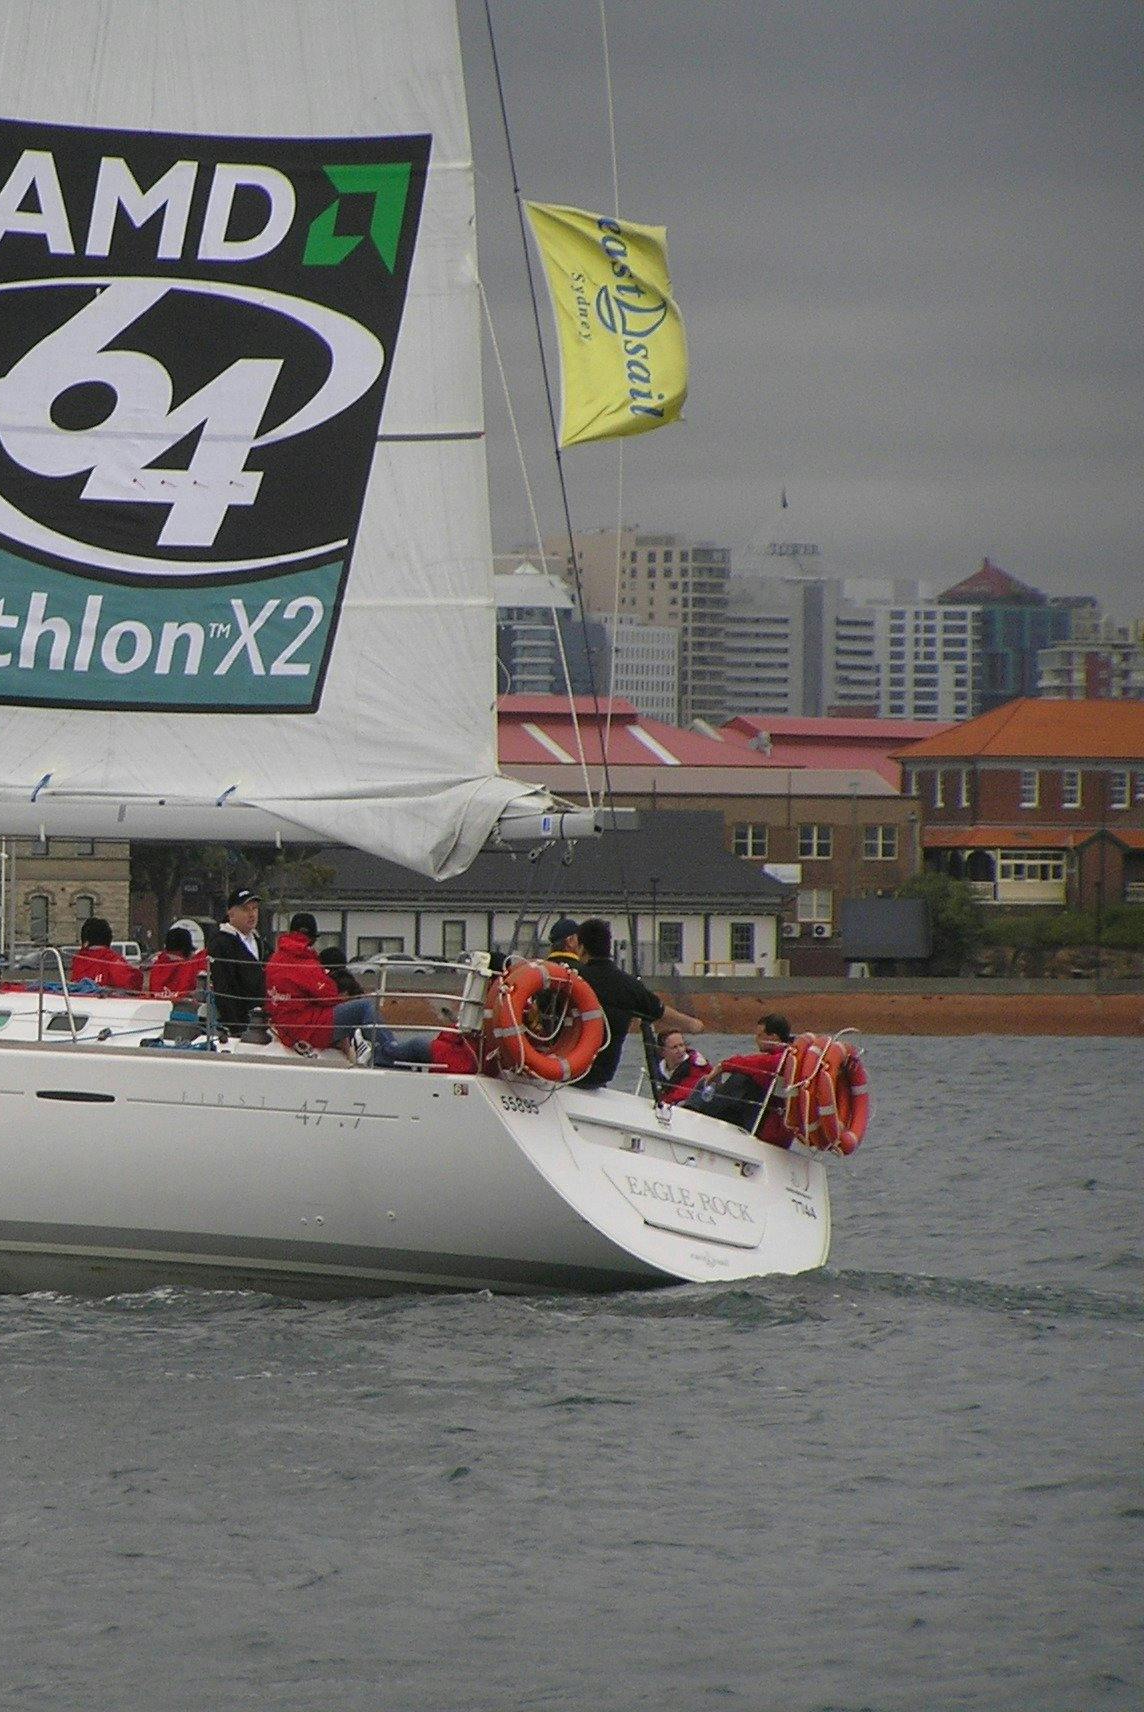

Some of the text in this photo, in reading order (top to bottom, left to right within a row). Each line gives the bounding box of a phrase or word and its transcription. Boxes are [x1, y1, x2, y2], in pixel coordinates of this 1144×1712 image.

[569, 270, 593, 343] Sydney
[214, 595, 325, 677] X2
[295, 1099, 366, 1130] 47.7
[625, 1175, 756, 1224] EAGLE ROCK
